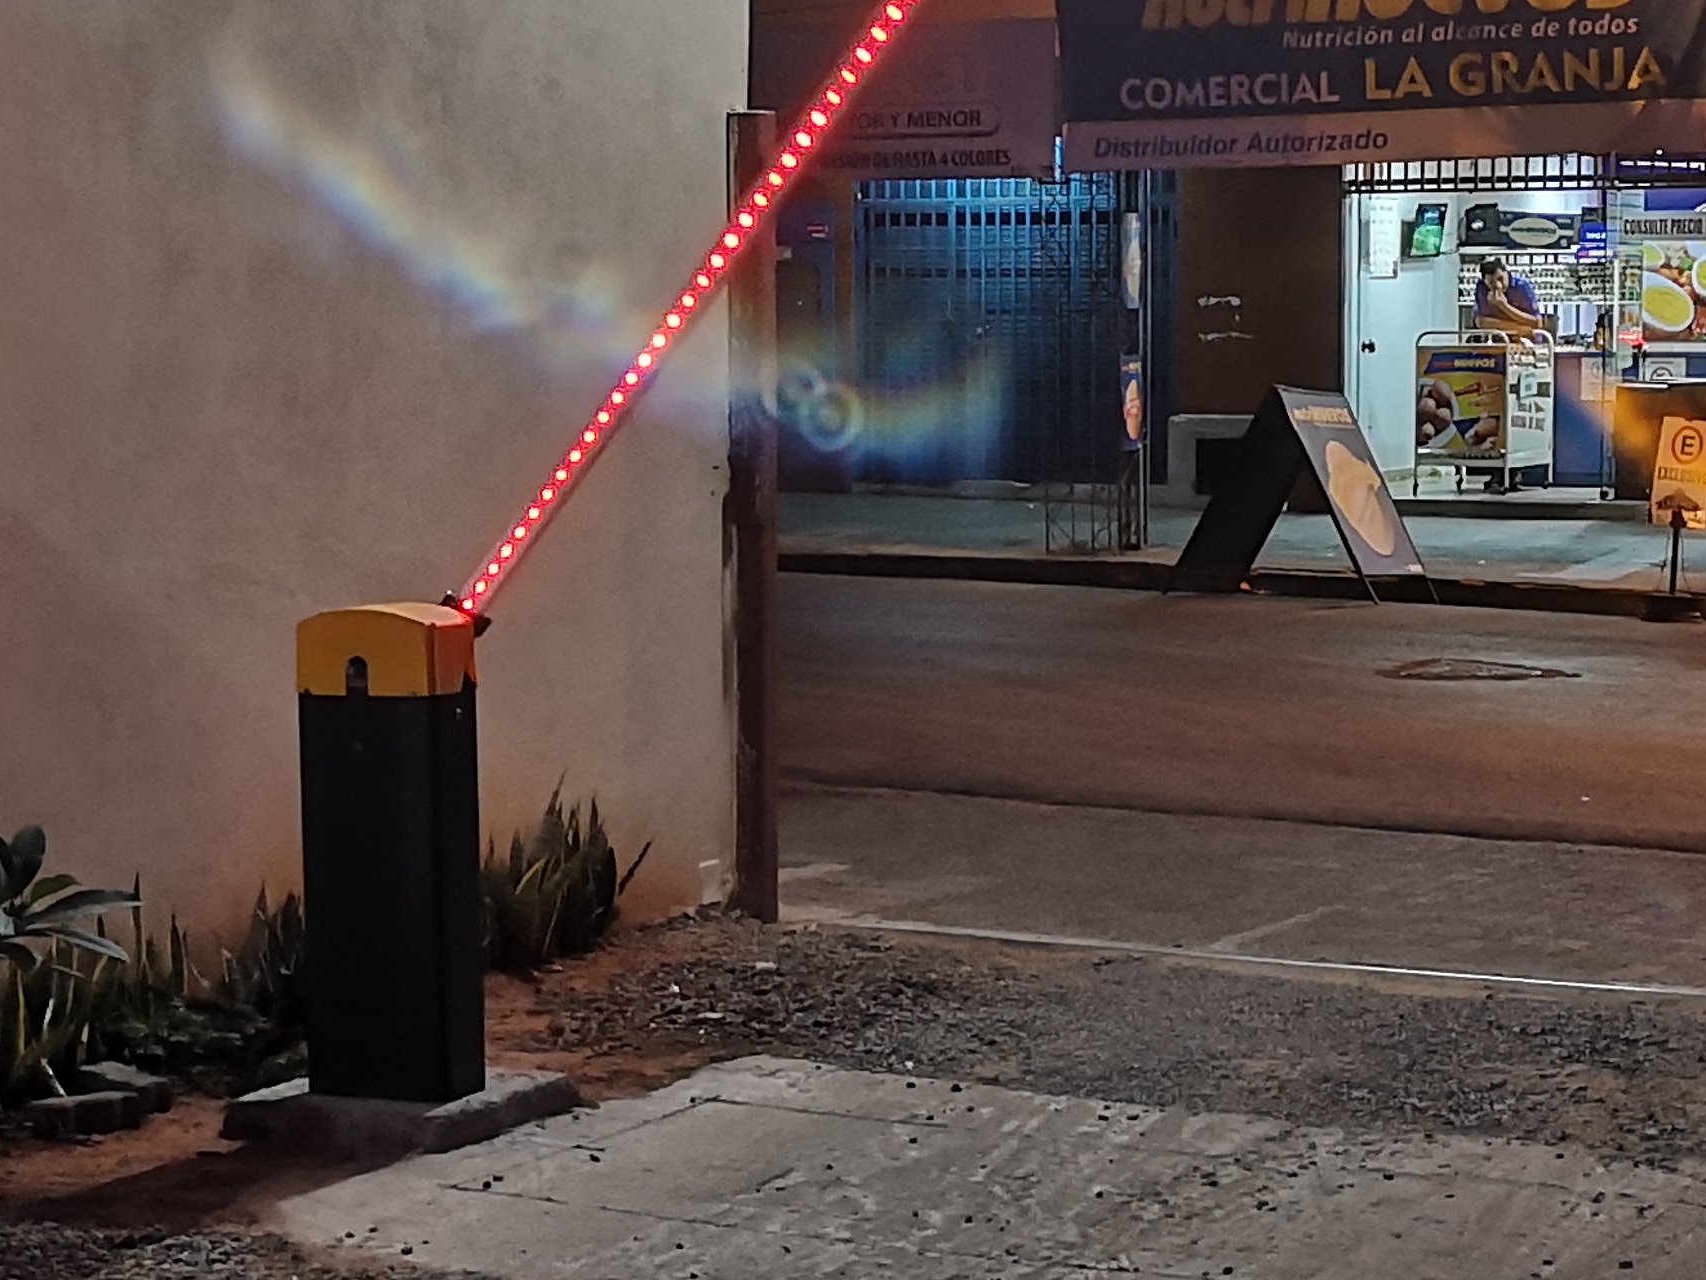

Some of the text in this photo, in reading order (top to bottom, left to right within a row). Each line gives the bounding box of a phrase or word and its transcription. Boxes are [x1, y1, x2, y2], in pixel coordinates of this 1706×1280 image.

[1282, 12, 1640, 50] Nutrición al alcance de todos
[1119, 45, 1668, 111] COMERCIAL LA GRANJA
[906, 109, 982, 128] MENOR
[1094, 129, 1390, 160] Distribuidor Autorizado
[894, 150, 937, 167] HASTA
[939, 151, 948, 166] 4
[950, 148, 1012, 166] COLORES
[1623, 218, 1669, 236] CONSULTE
[1670, 218, 1703, 235] PRECIO
[1680, 434, 1696, 456] E
